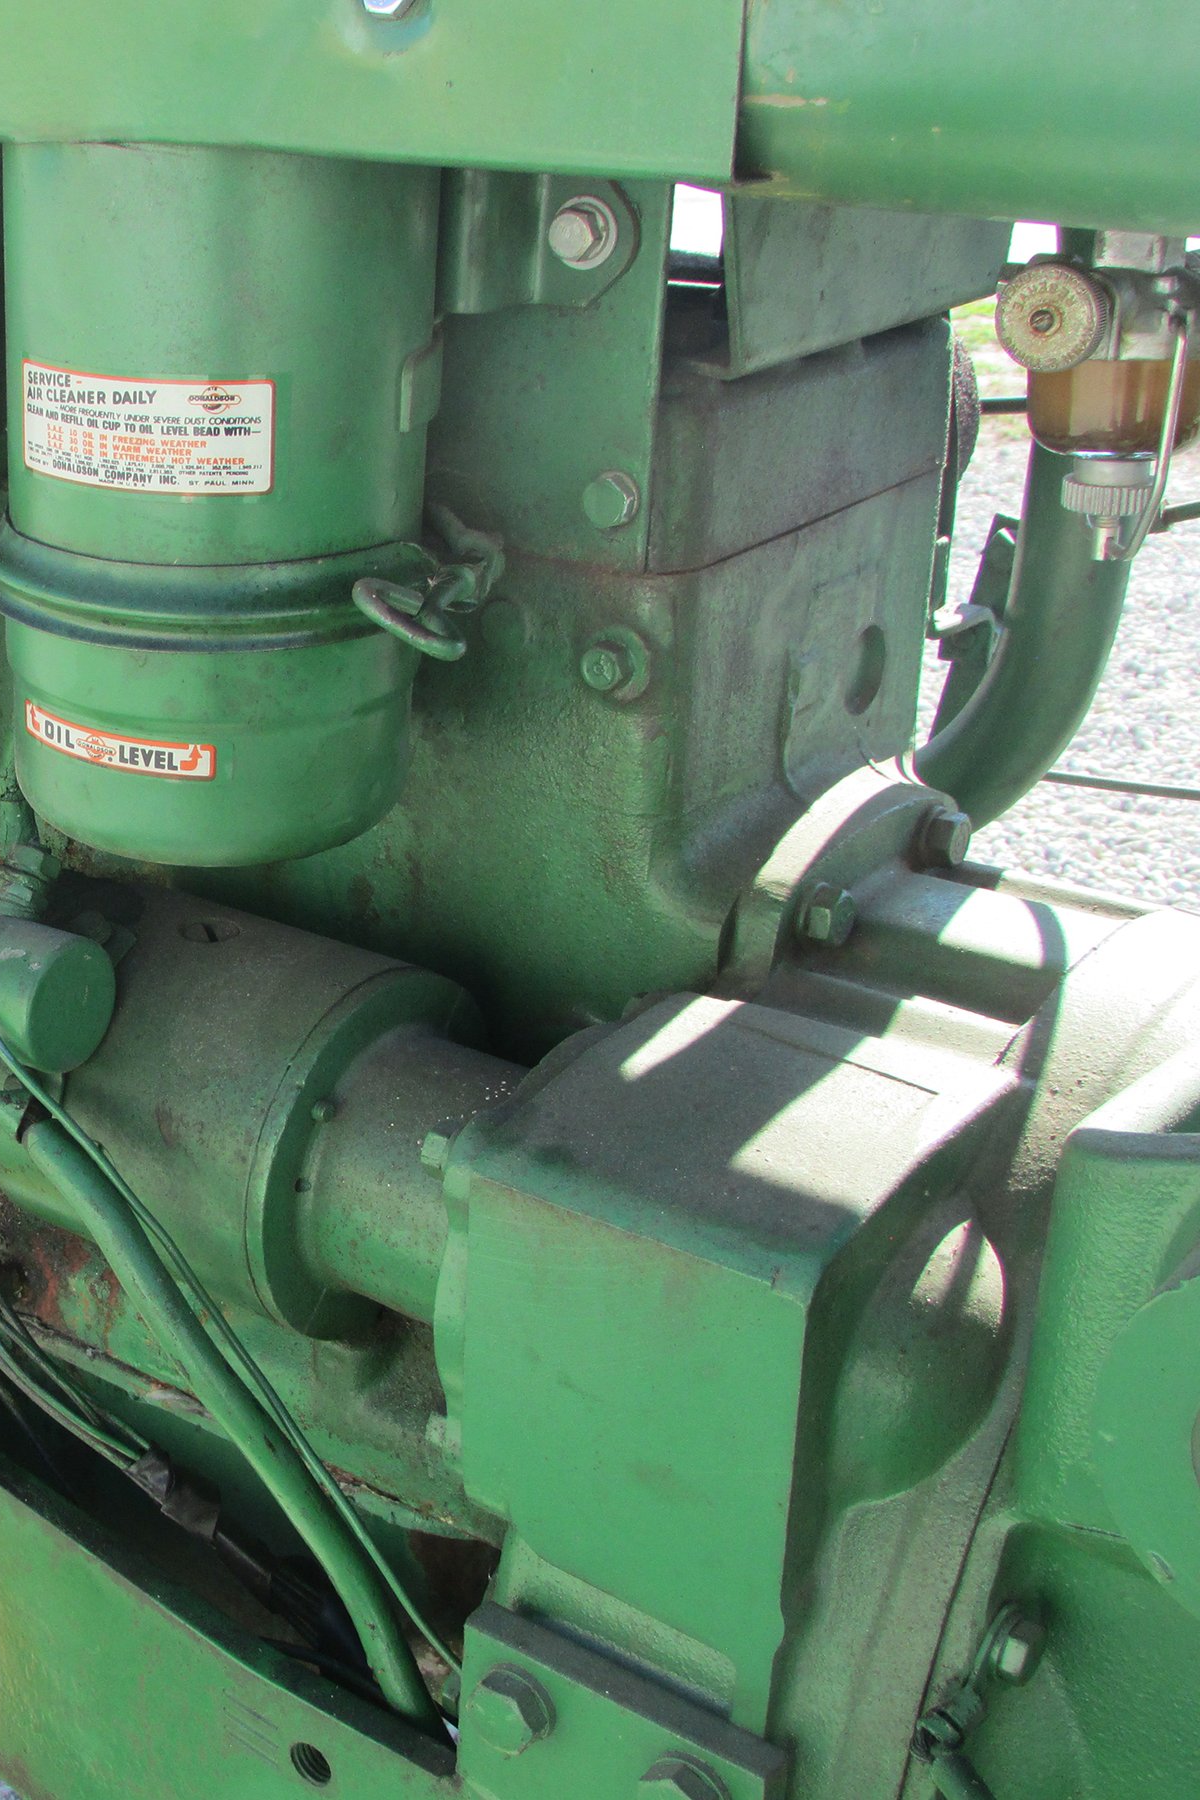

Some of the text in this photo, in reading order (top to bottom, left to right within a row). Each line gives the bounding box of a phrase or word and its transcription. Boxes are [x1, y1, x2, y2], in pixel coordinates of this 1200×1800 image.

[28, 371, 70, 387] SERVICE
[27, 387, 156, 404] AIR CLEANER DAILY
[27, 403, 43, 416] CLEAN
[46, 410, 58, 421] AND
[61, 413, 83, 426] REFILL
[87, 418, 99, 428] OIL
[102, 421, 120, 431] CUP
[124, 423, 136, 433] TO
[140, 424, 153, 434] OIL
[161, 426, 189, 436] LEVEL
[193, 427, 220, 436] BEAD
[60, 405, 76, 414] MORE
[79, 408, 120, 420] FREQUENTLY
[124, 414, 149, 423] UNDER
[153, 416, 180, 424] SEVERE
[209, 417, 261, 425] CONDITIONS
[70, 429, 77, 437] 10
[82, 431, 94, 440] OIL
[112, 435, 155, 446] FREEZING
[161, 440, 207, 448] WEATHER
[70, 437, 78, 445] 30
[82, 440, 94, 448] OIL
[112, 444, 141, 453] WARM
[146, 448, 192, 456] WEATHER
[82, 448, 94, 456] OIL
[113, 452, 166, 463] EXTREMELY
[53, 460, 99, 476] DONALDSON
[105, 470, 153, 483] COMPANY
[160, 475, 180, 485] INC.
[45, 719, 178, 771] OIL LEVEL
[78, 740, 113, 754] DONALDSON
